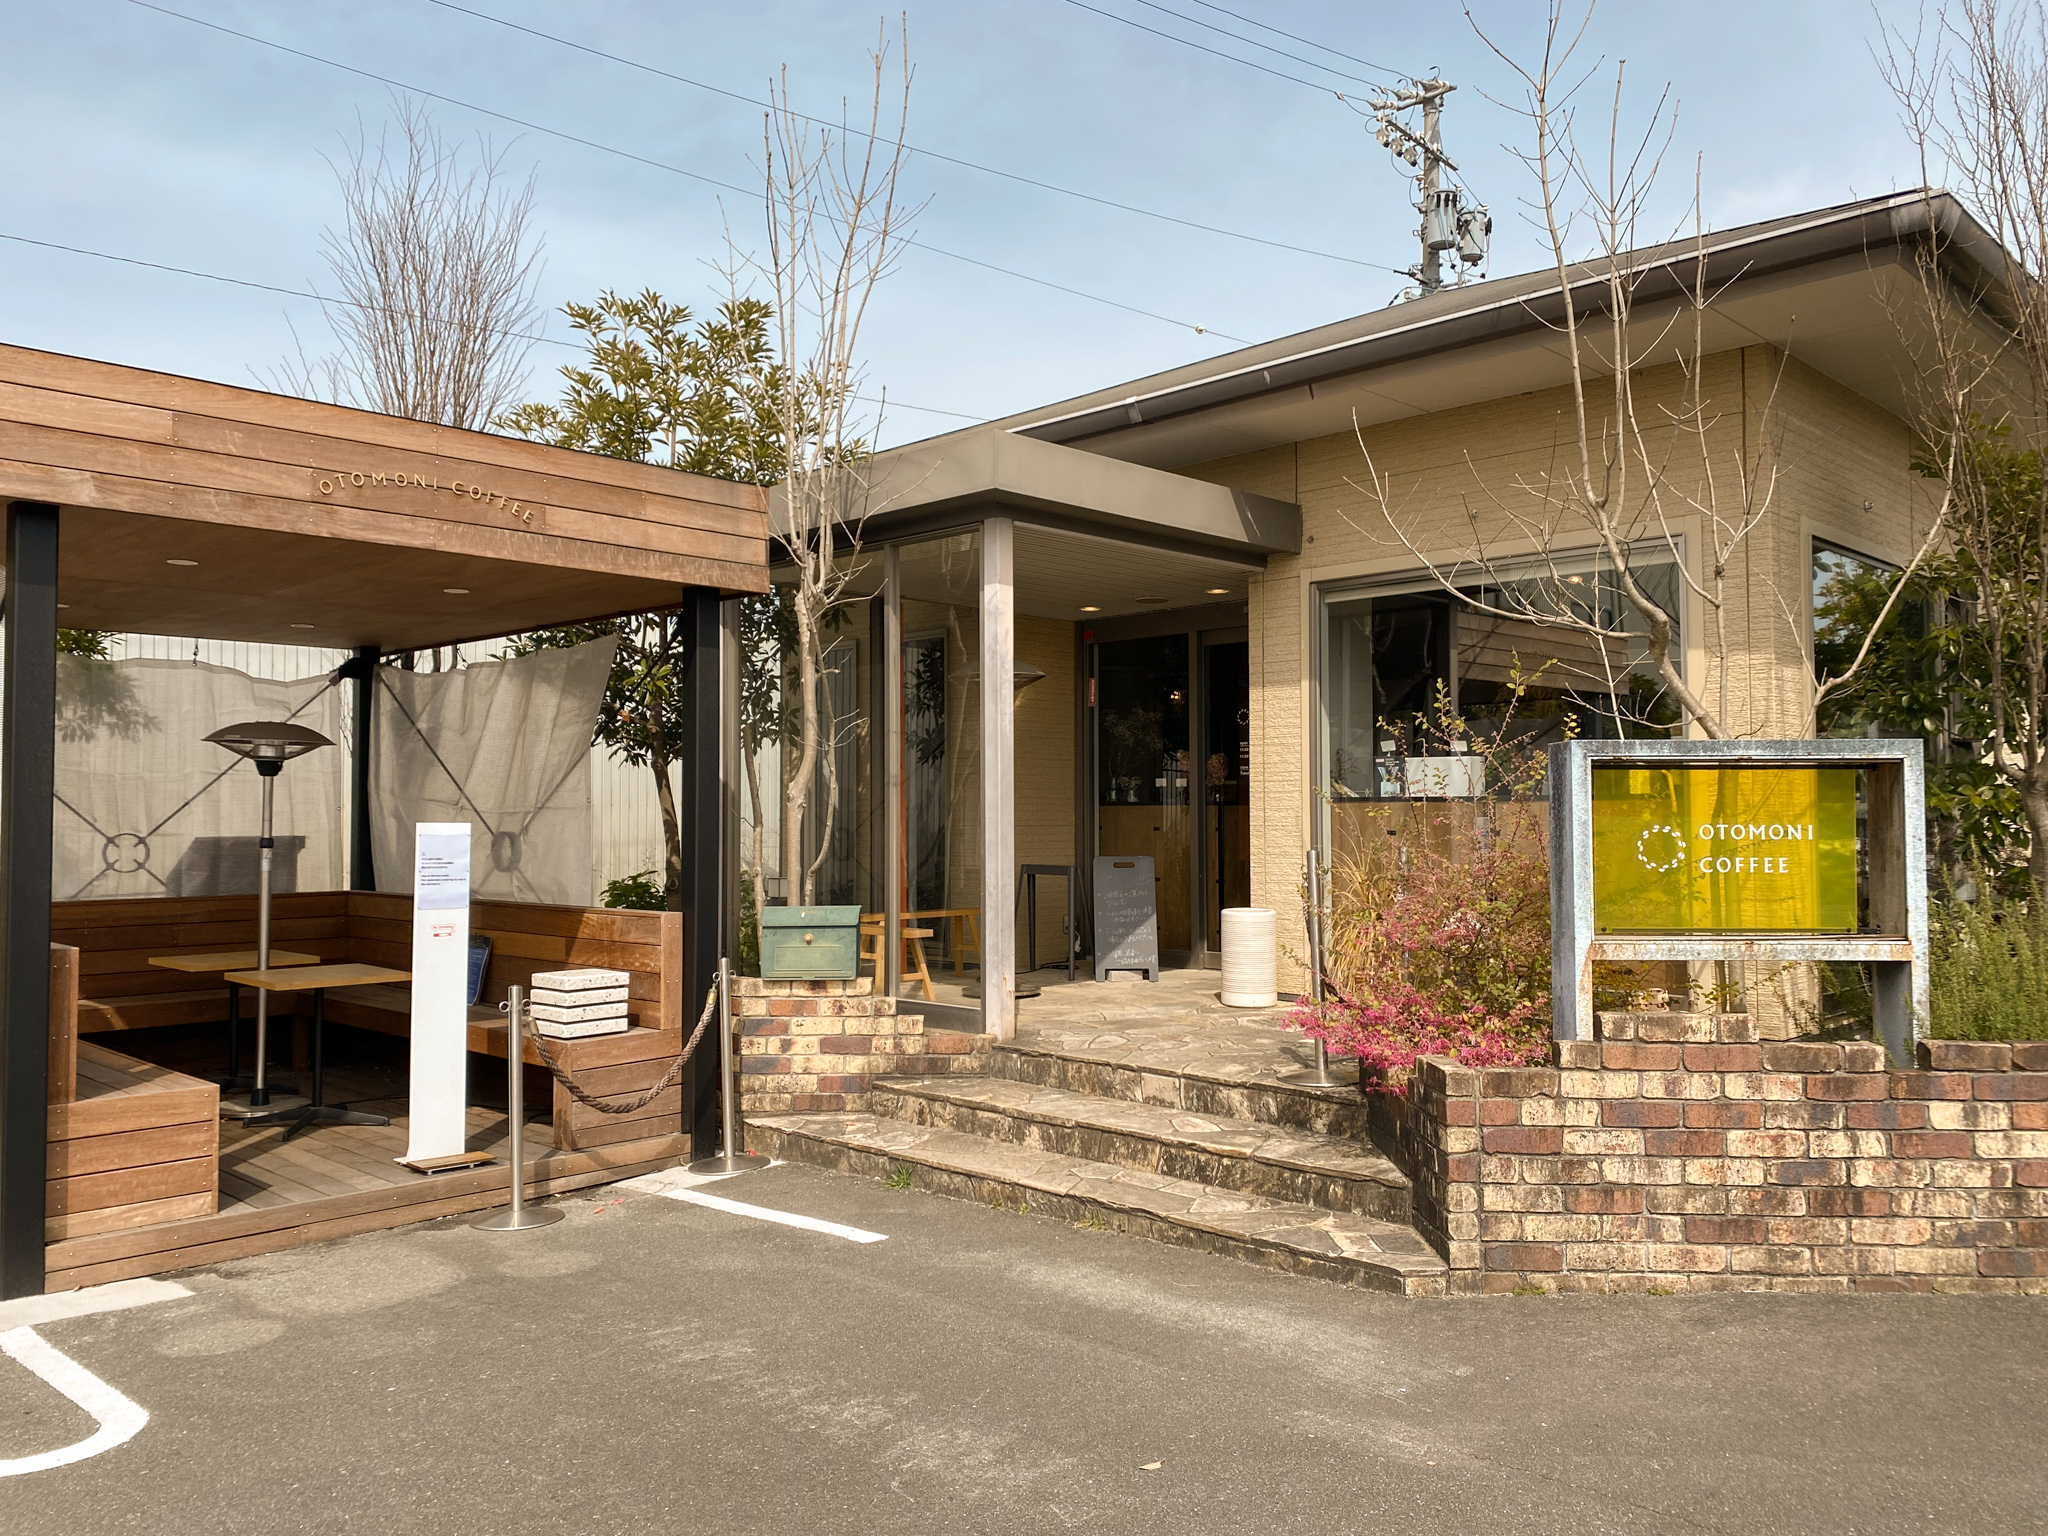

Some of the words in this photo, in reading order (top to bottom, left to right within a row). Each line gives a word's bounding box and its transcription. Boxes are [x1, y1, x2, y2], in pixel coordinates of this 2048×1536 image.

[319, 471, 438, 495] OTOMONI
[452, 480, 534, 524] COFFEE
[1699, 824, 1814, 840] OTOMONI
[1699, 857, 1790, 873] COFFEE
